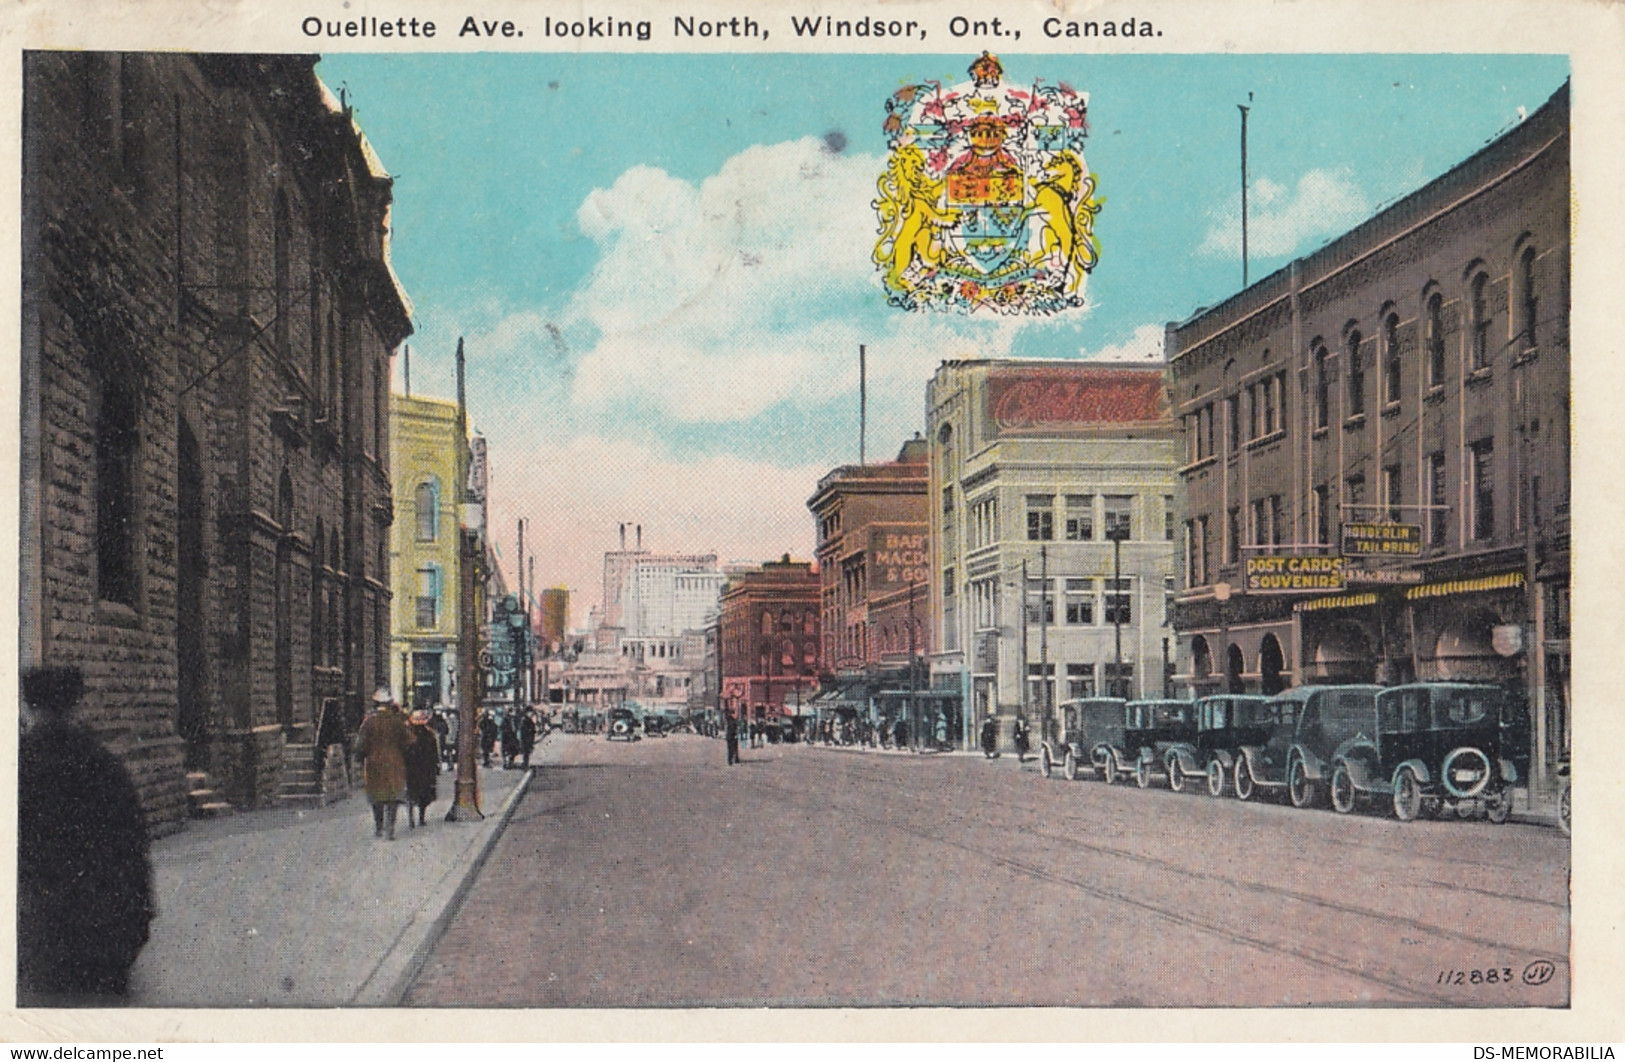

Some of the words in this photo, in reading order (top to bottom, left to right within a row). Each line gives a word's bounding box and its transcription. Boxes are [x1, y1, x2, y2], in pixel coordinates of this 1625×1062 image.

[301, 16, 437, 38] Ouellette
[459, 16, 524, 38] Ave.
[545, 16, 652, 41] looking
[674, 16, 769, 40] North,
[791, 16, 928, 40] Windsor,
[949, 16, 1022, 40] Ont.,
[1043, 17, 1164, 38] Canada.
[1357, 541, 1419, 553] TAILORING
[1247, 558, 1285, 575] POST
[1288, 558, 1343, 573] CARDS
[1249, 575, 1340, 588] SOUVENIRS
[1437, 968, 1514, 986] 112883
